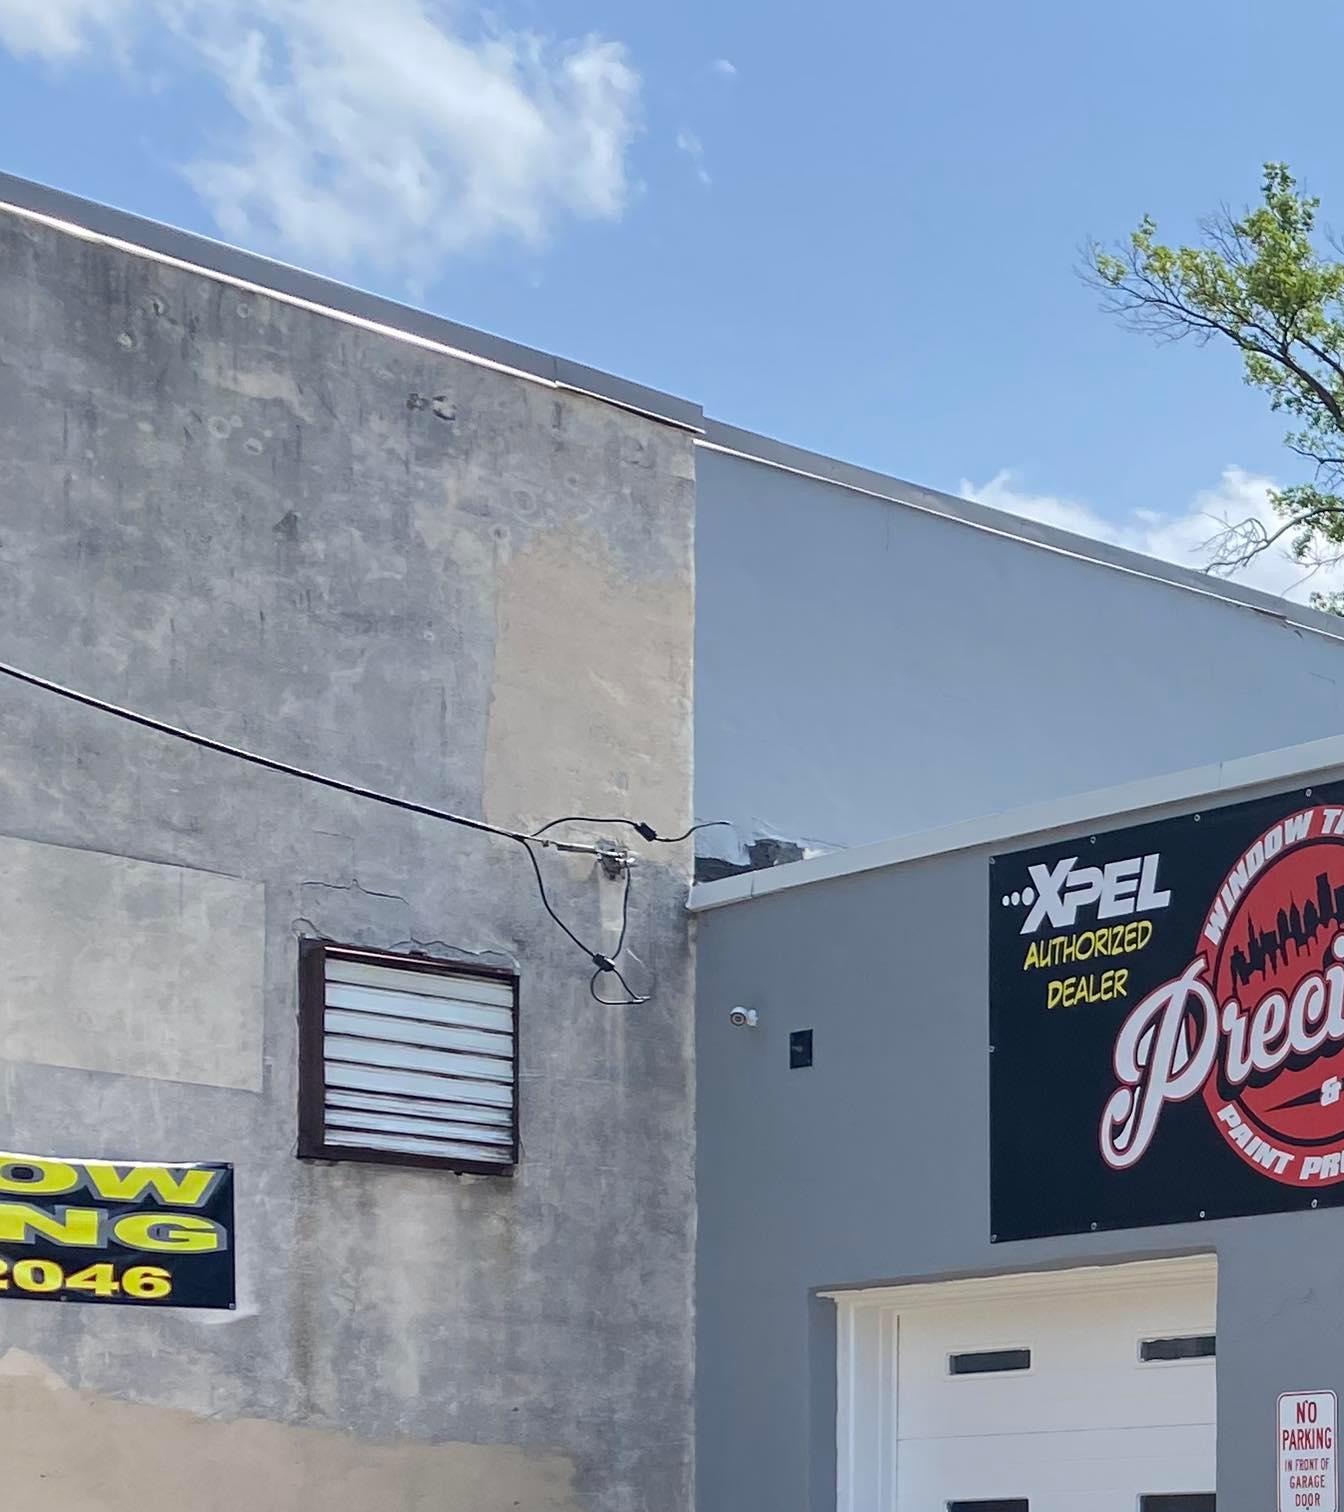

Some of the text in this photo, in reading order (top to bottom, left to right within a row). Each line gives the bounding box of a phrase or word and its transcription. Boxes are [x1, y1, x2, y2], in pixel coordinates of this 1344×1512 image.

[1203, 809, 1314, 946] WINDOW
[1019, 853, 1172, 935] XPEL
[1023, 920, 1153, 971] AUTHORIZED
[1047, 968, 1129, 1009] DEALER
[1320, 1075, 1342, 1107] &
[1216, 1103, 1295, 1175] PAINT
[1296, 1401, 1318, 1424] NO
[1282, 1427, 1333, 1451] PARKING
[1285, 1457, 1331, 1471] IN FRONT OF
[1289, 1474, 1326, 1489] GARAGE
[1295, 1492, 1321, 1507] DOOR
